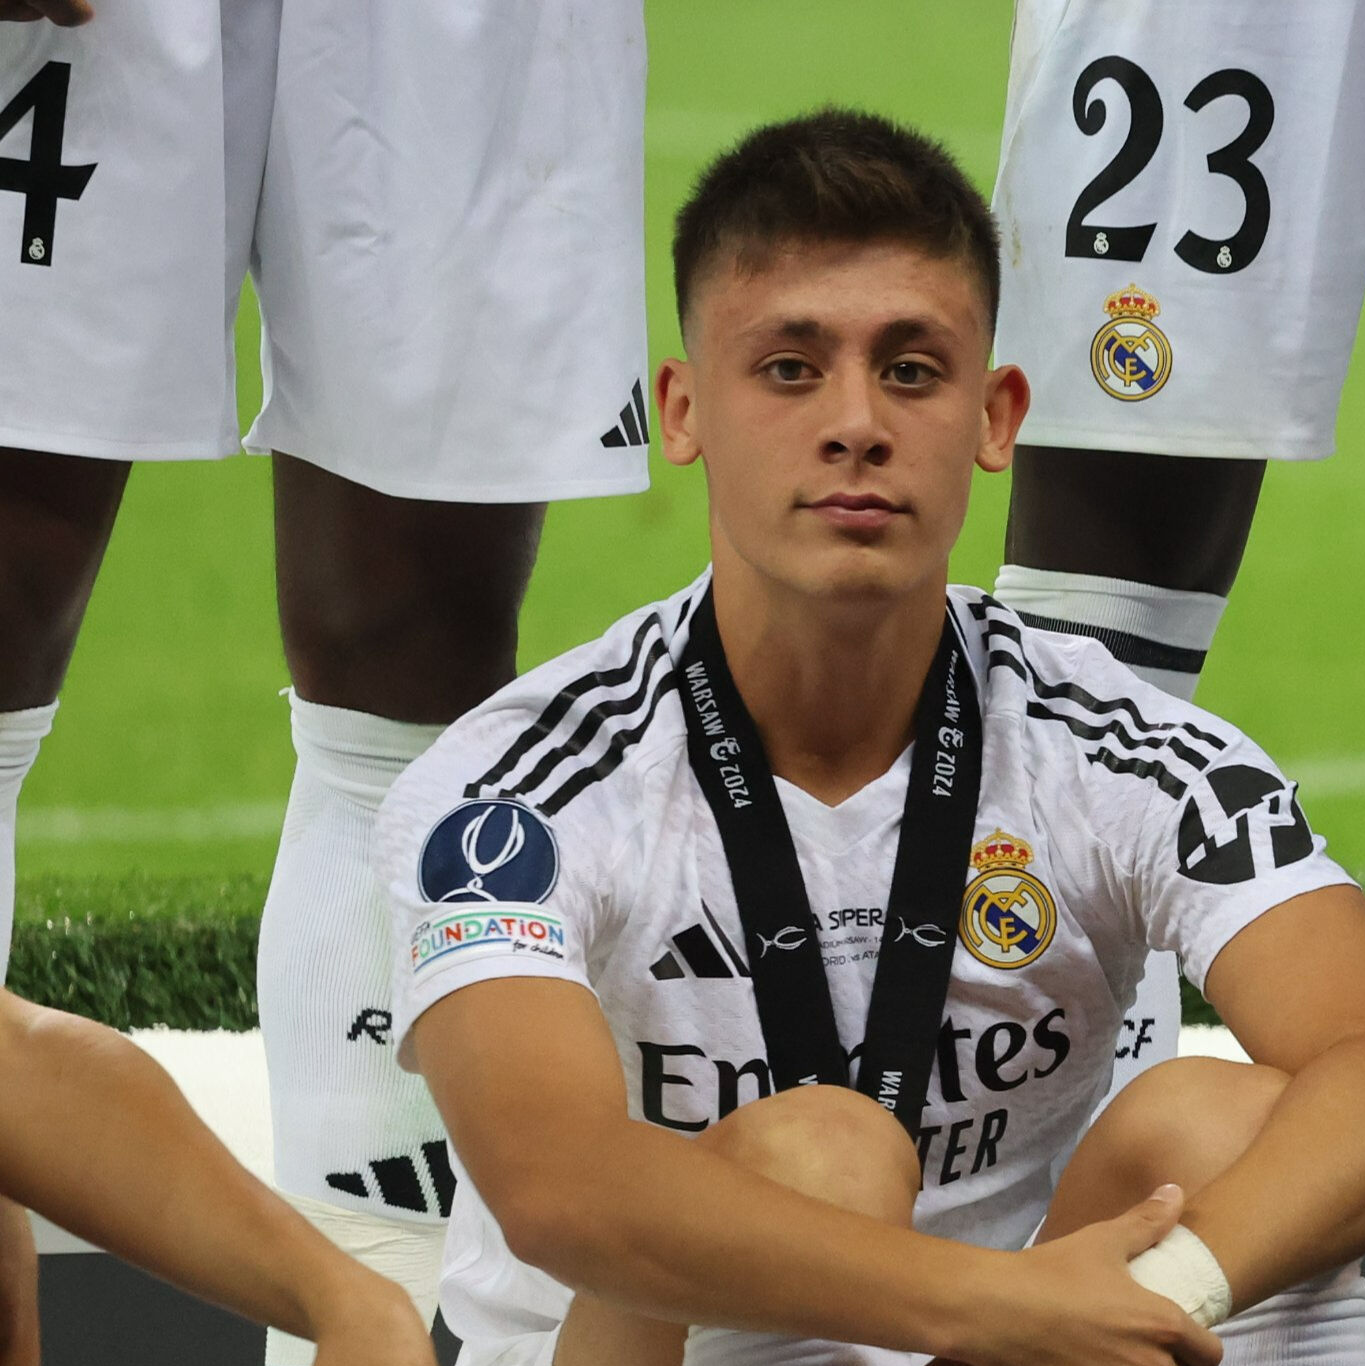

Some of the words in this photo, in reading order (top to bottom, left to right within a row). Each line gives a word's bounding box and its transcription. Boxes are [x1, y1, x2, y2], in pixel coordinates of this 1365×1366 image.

[1064, 55, 1275, 275] 23
[685, 661, 727, 737] WARSAW
[719, 763, 753, 809] 2024
[932, 751, 957, 797] 2024
